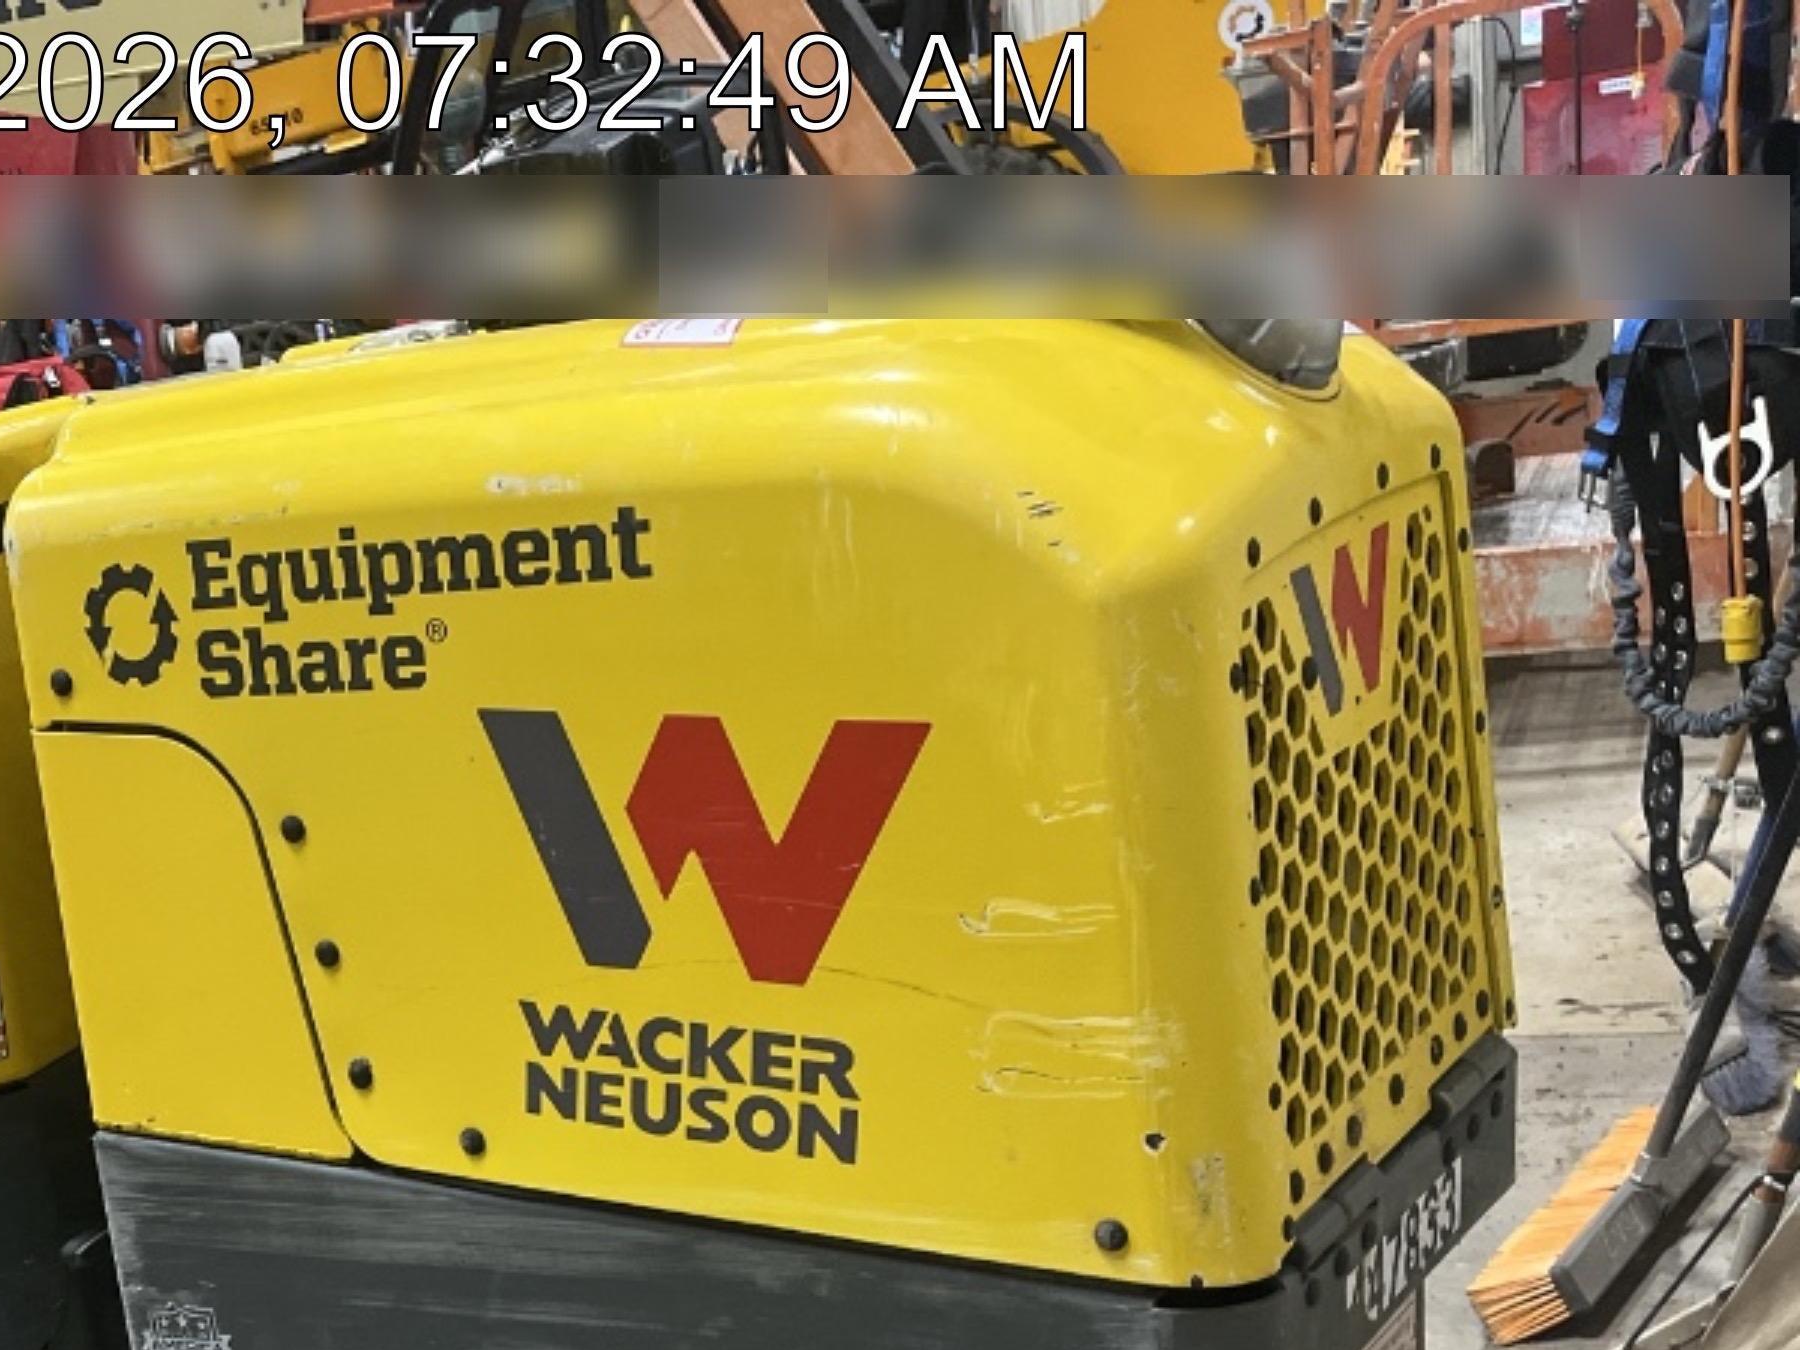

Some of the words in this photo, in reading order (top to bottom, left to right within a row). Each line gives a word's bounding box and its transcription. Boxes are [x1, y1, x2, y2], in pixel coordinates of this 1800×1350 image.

[186, 506, 652, 624] Equipment
[519, 999, 861, 1101] WACKER
[526, 1061, 859, 1165] NEUSON
